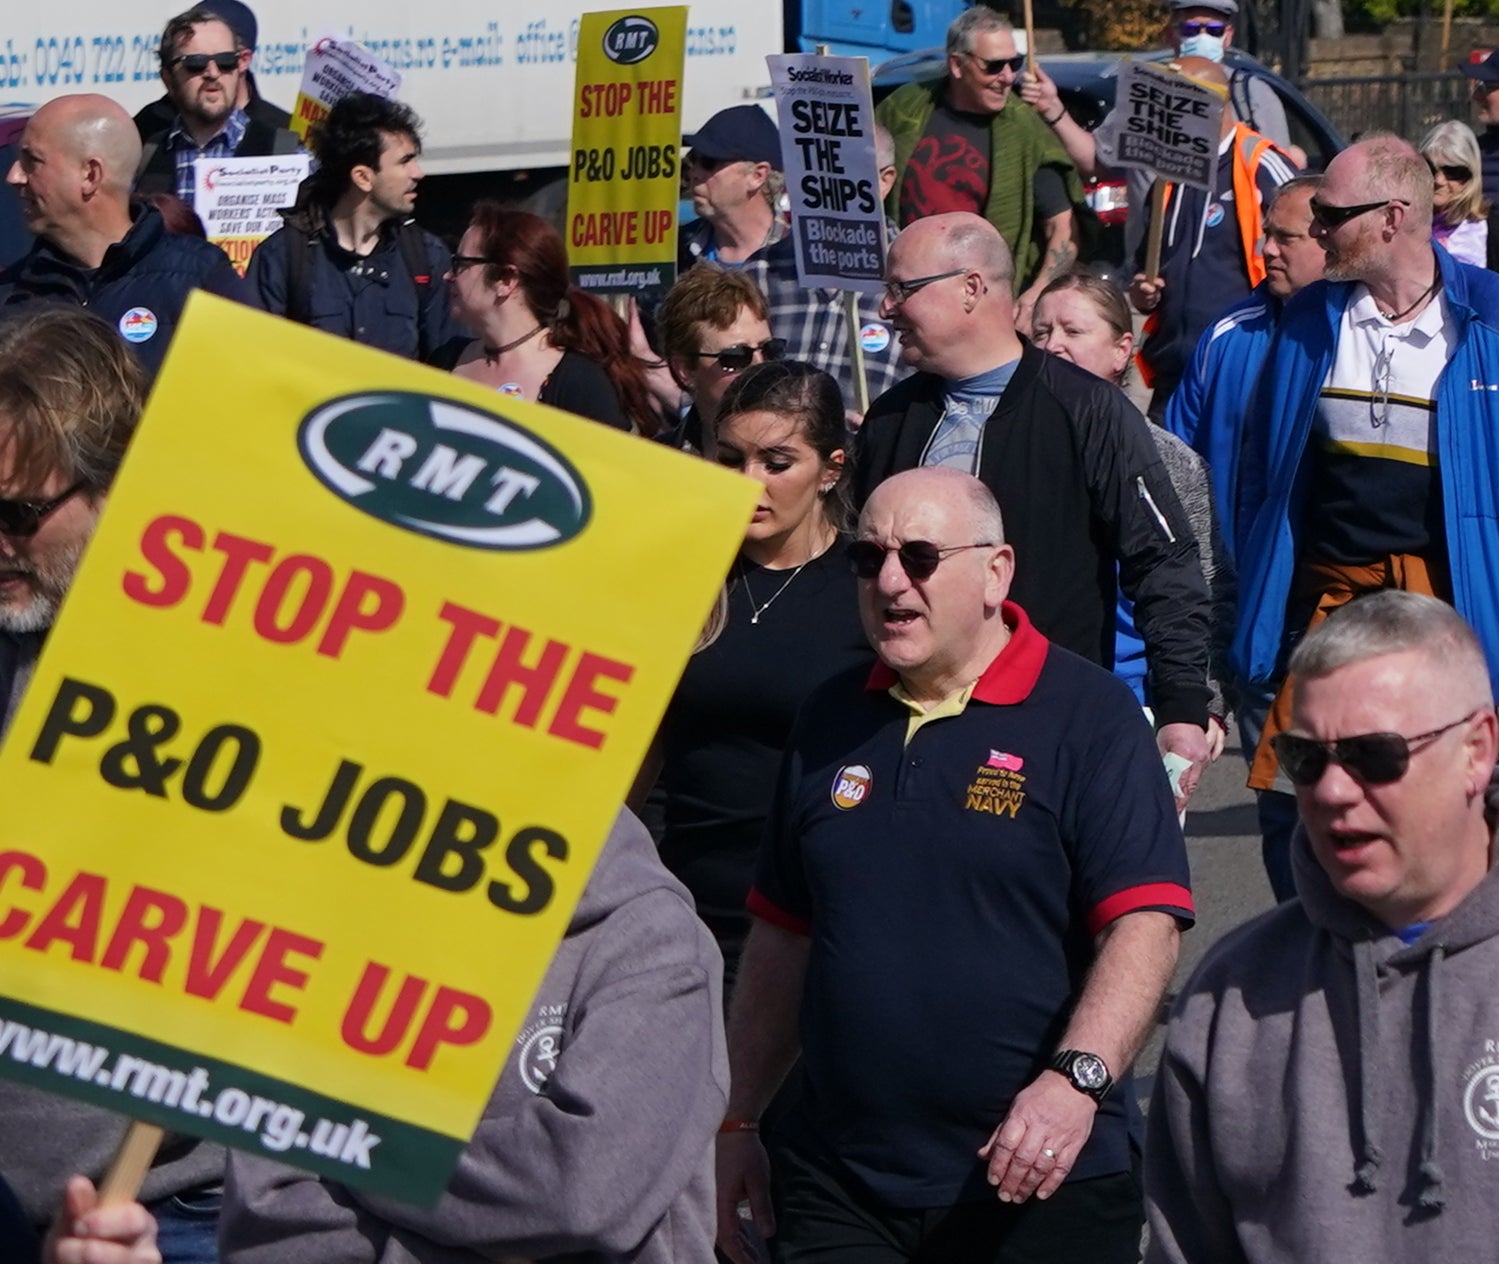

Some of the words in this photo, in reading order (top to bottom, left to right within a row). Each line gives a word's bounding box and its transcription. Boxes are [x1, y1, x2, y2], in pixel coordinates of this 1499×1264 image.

[615, 29, 650, 51] RMT
[35, 36, 86, 86] 0040
[580, 82, 632, 119] STOP
[638, 79, 677, 115] THE
[791, 99, 863, 137] SEIZE
[1129, 82, 1210, 119] SEIZE
[1129, 98, 1184, 132] THE
[1127, 116, 1210, 154] SHIPS
[574, 147, 615, 183] P&O
[621, 144, 675, 180] JOBS
[795, 137, 845, 175] THE
[801, 175, 876, 214] SHIPS
[571, 211, 640, 248] CARVE
[645, 209, 673, 245] UP
[806, 219, 878, 246] Blockade
[809, 243, 837, 267] the
[838, 247, 880, 272] ports
[579, 268, 661, 289] www.rmt.org.uk
[356, 428, 542, 517] RMT
[121, 512, 406, 662] STOP
[426, 599, 636, 751] THE
[28, 675, 263, 815] P&O
[278, 758, 570, 918] JOBS
[837, 779, 865, 801] P&O
[964, 795, 1022, 819] NAVY
[967, 785, 1026, 802] MERCHANT
[0, 847, 325, 1026] CARVE
[338, 958, 495, 1073] UP
